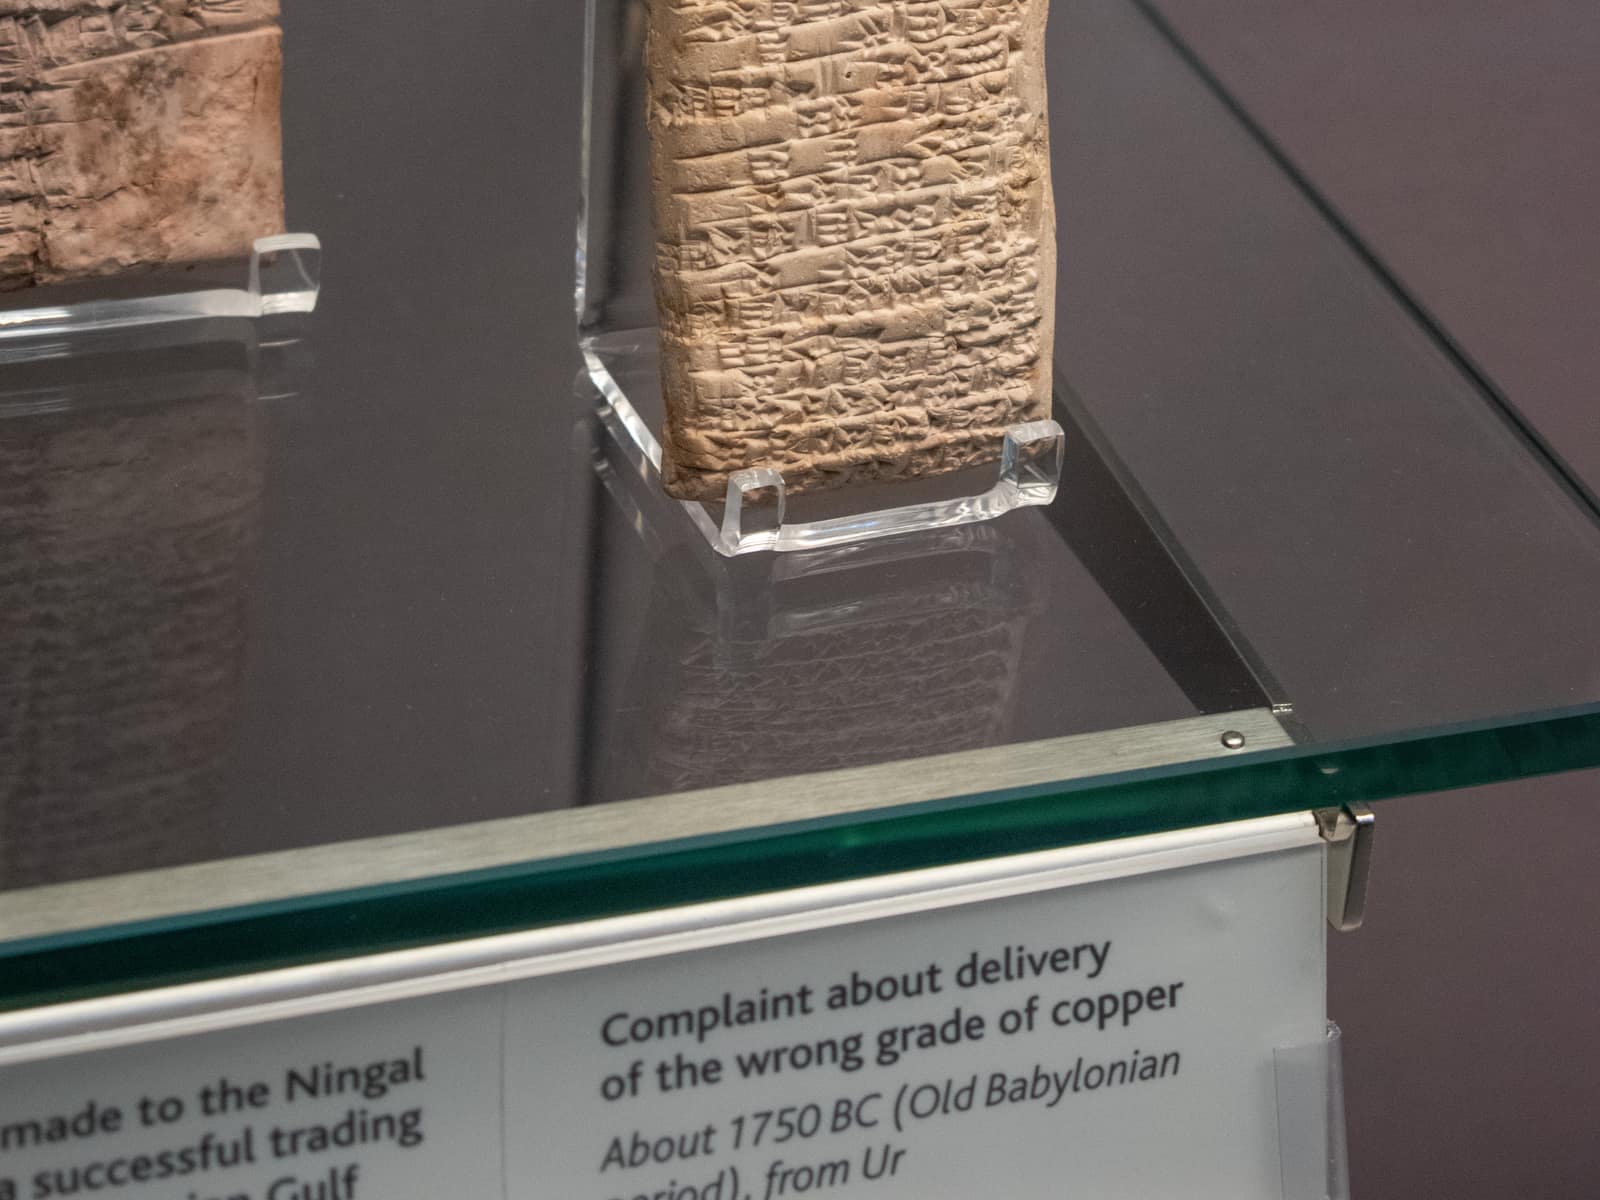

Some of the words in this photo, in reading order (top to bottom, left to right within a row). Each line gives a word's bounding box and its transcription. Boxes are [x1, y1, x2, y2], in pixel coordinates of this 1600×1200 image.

[600, 985, 813, 1047] Complaint
[827, 964, 942, 1010] about
[956, 941, 1111, 988] delivery
[601, 1060, 643, 1101] of
[656, 1053, 722, 1092] the
[736, 1033, 864, 1078] wrong
[876, 1008, 985, 1066] grade
[999, 995, 1040, 1035] of
[1052, 982, 1184, 1030] copper
[1, 1101, 122, 1150] made
[138, 1095, 184, 1127] to
[199, 1078, 270, 1117] the
[286, 1046, 424, 1102] Ningal
[600, 1126, 717, 1171] About
[732, 1104, 821, 1149] 1750
[831, 1093, 881, 1133] BC
[894, 1075, 975, 1132] (Old
[985, 1050, 1180, 1107] Babylonian
[34, 1128, 255, 1200] successful
[269, 1108, 424, 1158] trading
[267, 1163, 359, 1200] Gulf
[764, 1159, 850, 1200] from
[863, 1144, 907, 1180] Ur
